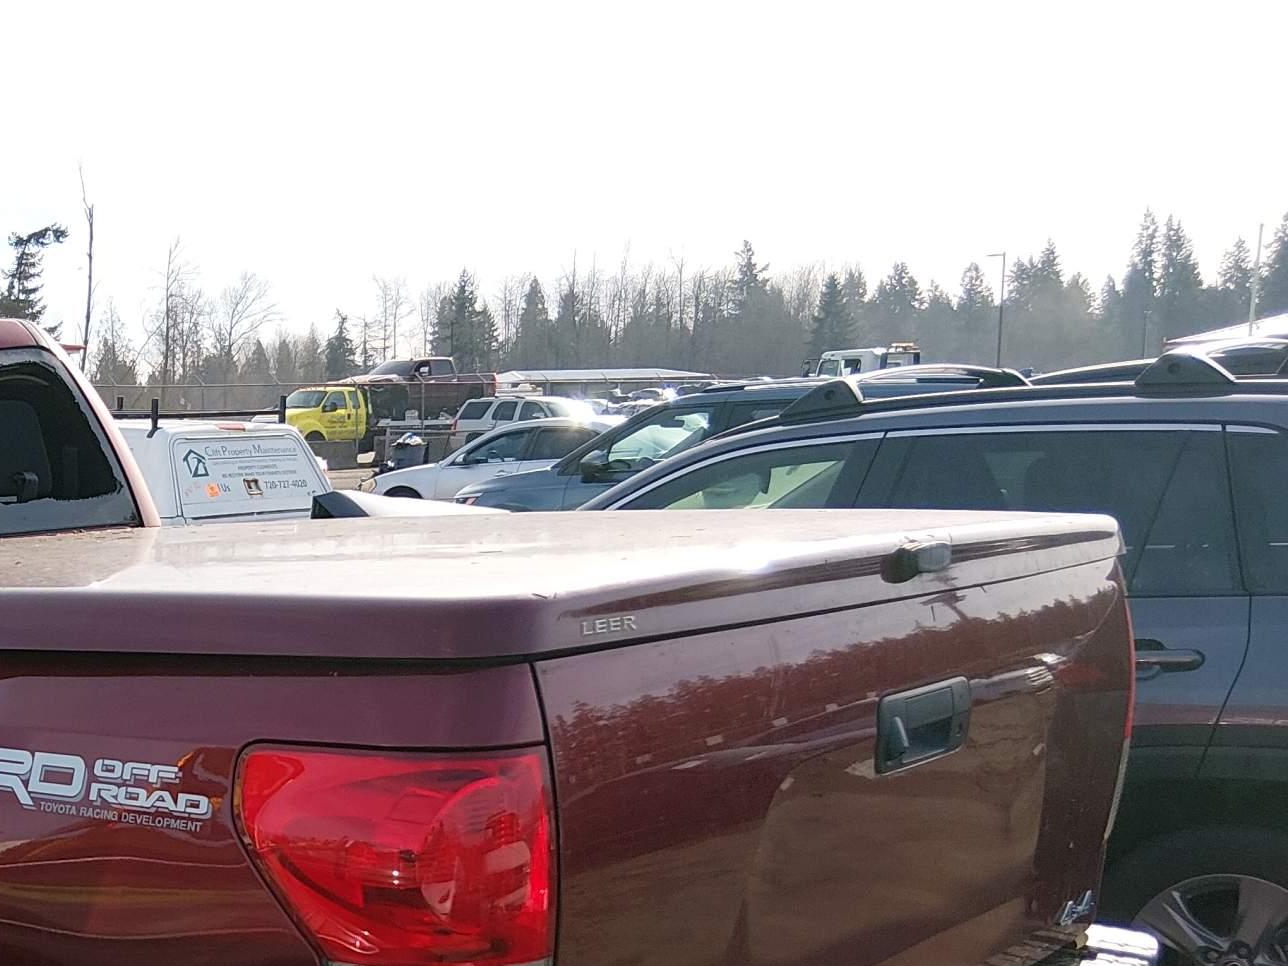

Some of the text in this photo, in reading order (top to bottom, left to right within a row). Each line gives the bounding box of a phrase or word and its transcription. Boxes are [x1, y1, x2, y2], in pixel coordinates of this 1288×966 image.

[581, 615, 637, 635] LEER
[93, 758, 183, 786] OFF
[88, 782, 212, 820] ROAD
[39, 801, 203, 832] TOYOTA RACING DEVELOPMENT
